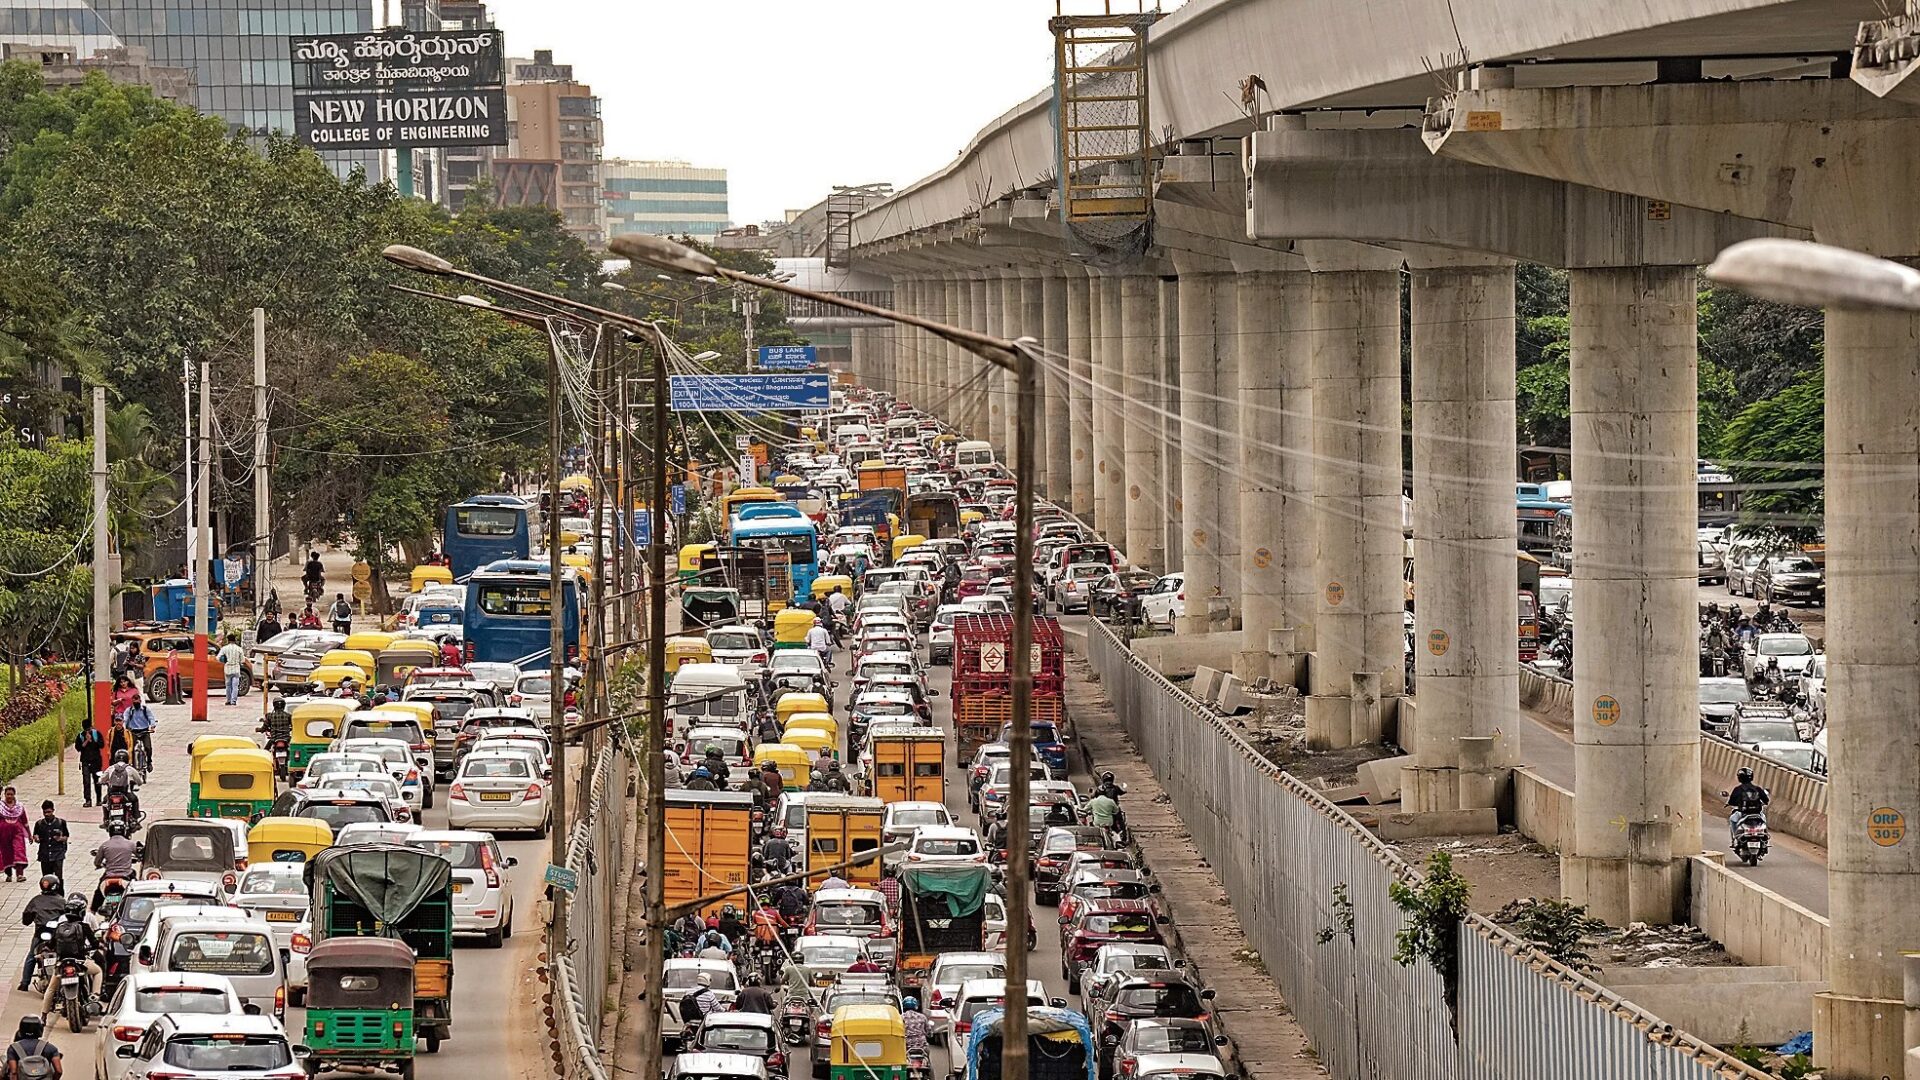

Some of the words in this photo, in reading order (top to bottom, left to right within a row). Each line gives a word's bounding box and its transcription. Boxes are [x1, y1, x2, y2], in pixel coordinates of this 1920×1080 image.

[296, 39, 350, 68] ನ್ಯೂ
[322, 67, 371, 84] ತಾಂತ್ರಿಕ
[375, 65, 470, 83] ಮಹಾವಿದ್ಯಾಲಯ
[519, 66, 571, 79] VAJRAM
[308, 99, 366, 124] NEW
[376, 96, 489, 122] HORIZON
[310, 127, 370, 143] COLLEGE
[376, 127, 393, 141] OF
[400, 124, 490, 141] ENGINEERING
[674, 390, 690, 398] EXIT
[1596, 700, 1615, 709] ORP
[1873, 814, 1899, 824] ORP
[1874, 829, 1900, 839] 305
[549, 869, 575, 882] STUDIO
